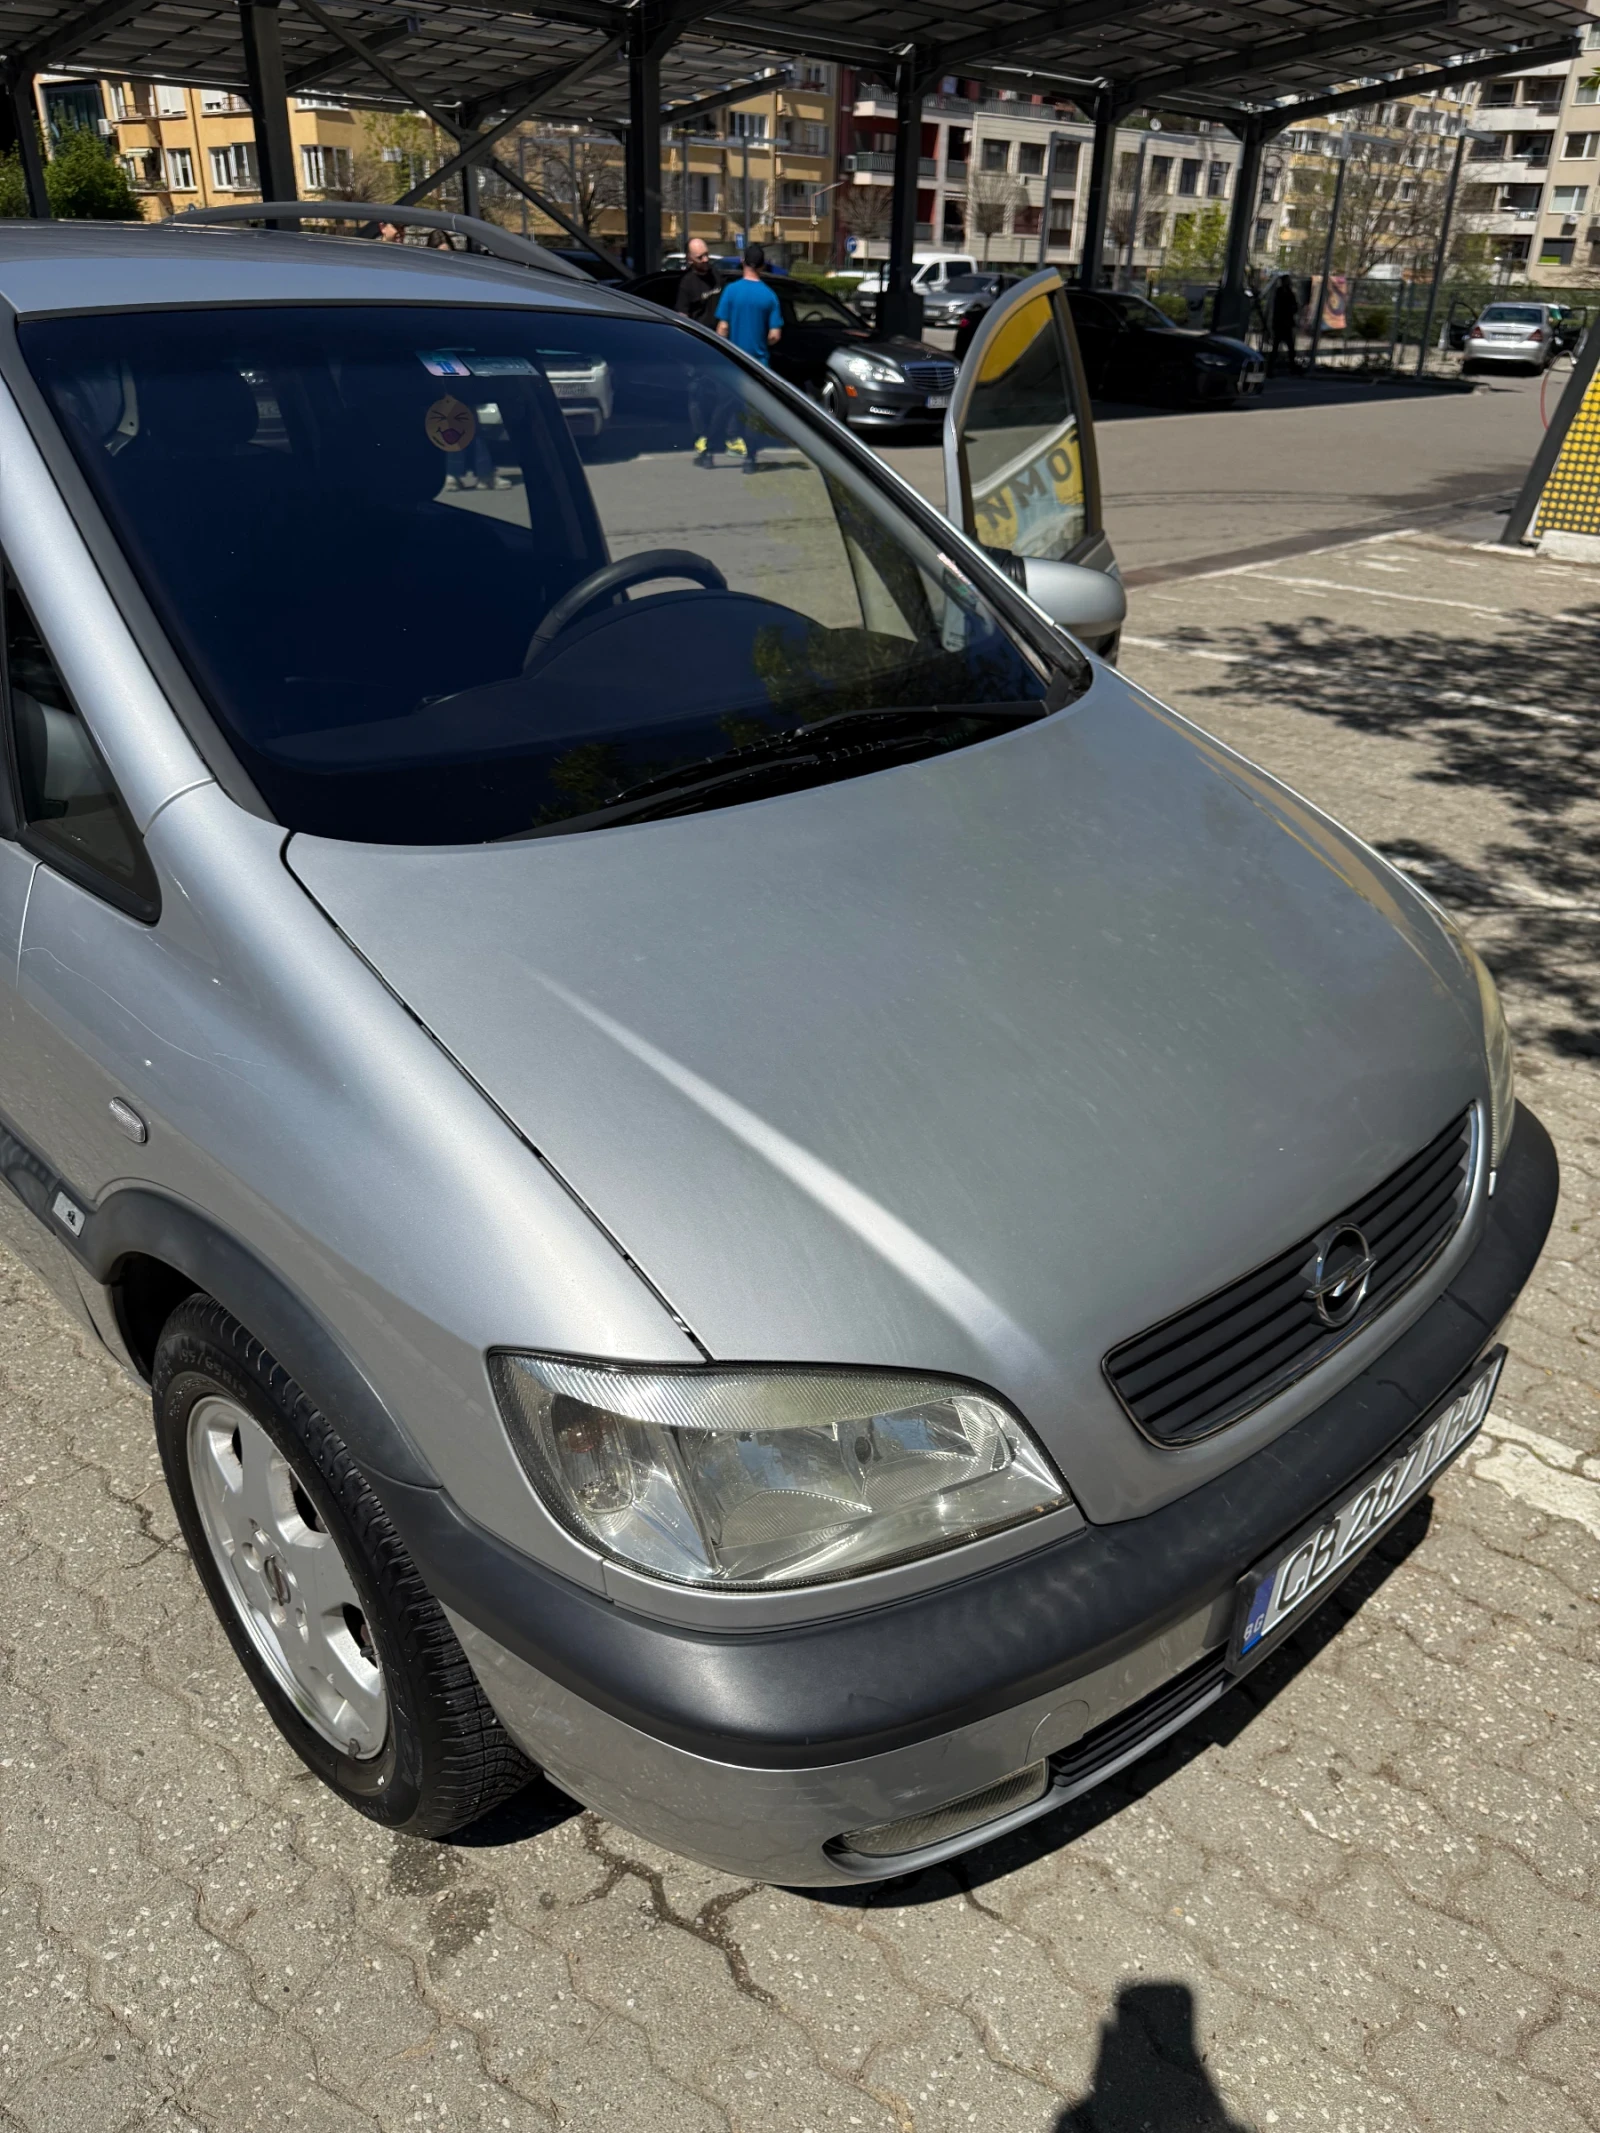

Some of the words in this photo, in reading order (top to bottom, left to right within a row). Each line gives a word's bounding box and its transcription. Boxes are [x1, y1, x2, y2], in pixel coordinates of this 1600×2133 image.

[1275, 1517, 1341, 1611] CB
[1338, 1422, 1440, 1557] 2871
[1243, 1613, 1265, 1640] BG
